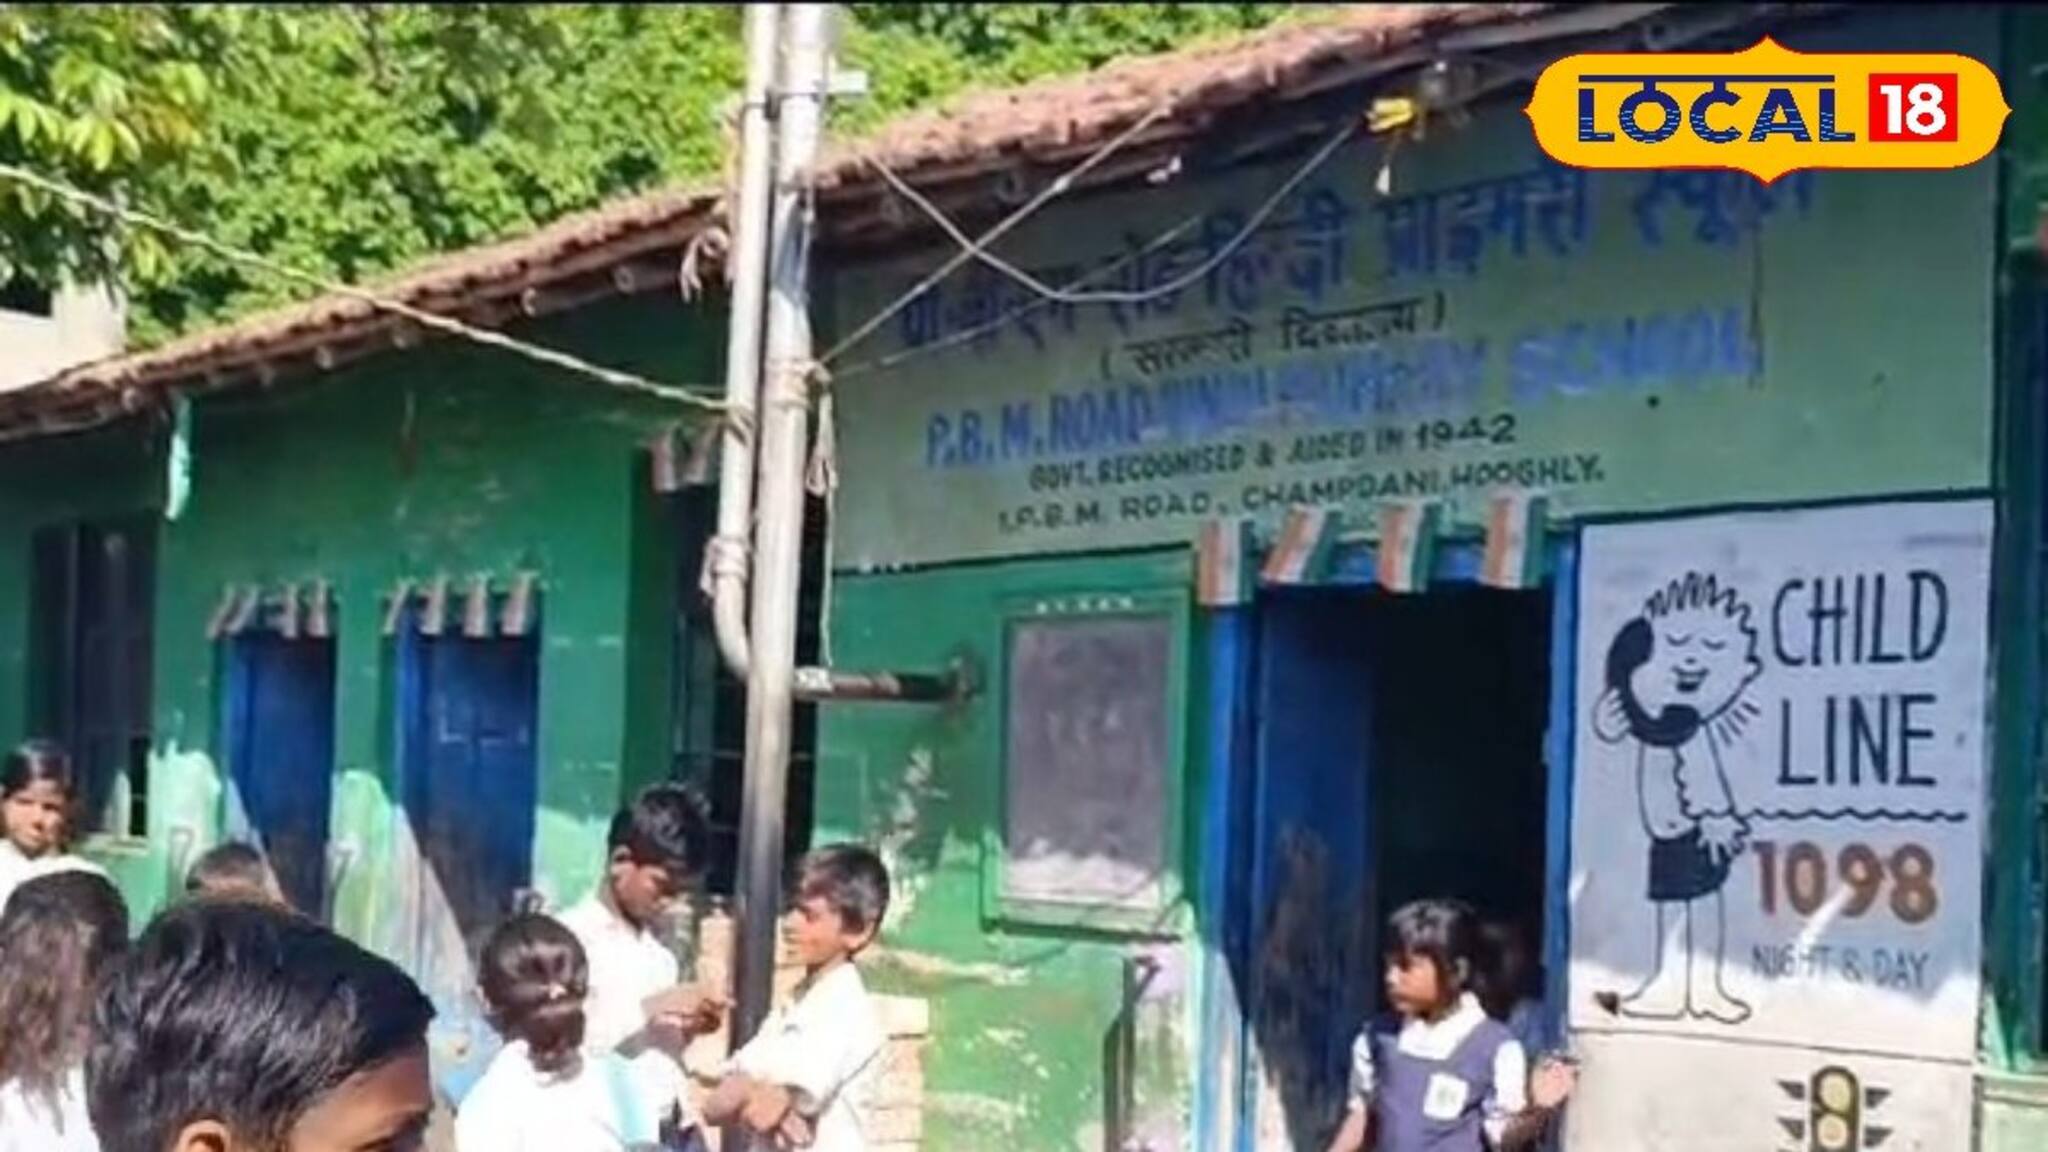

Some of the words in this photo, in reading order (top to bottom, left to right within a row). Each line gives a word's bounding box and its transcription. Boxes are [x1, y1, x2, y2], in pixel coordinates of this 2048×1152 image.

[1253, 440, 1276, 470] &
[1374, 427, 1404, 455] IN
[1414, 413, 1518, 452] 1942
[1770, 568, 1950, 670] CHILD
[1776, 693, 1938, 788] LINE
[1752, 841, 1939, 924] 1098
[1751, 944, 1830, 979] NIGHT
[1841, 948, 1864, 983] &
[1871, 948, 1930, 988] DAY
